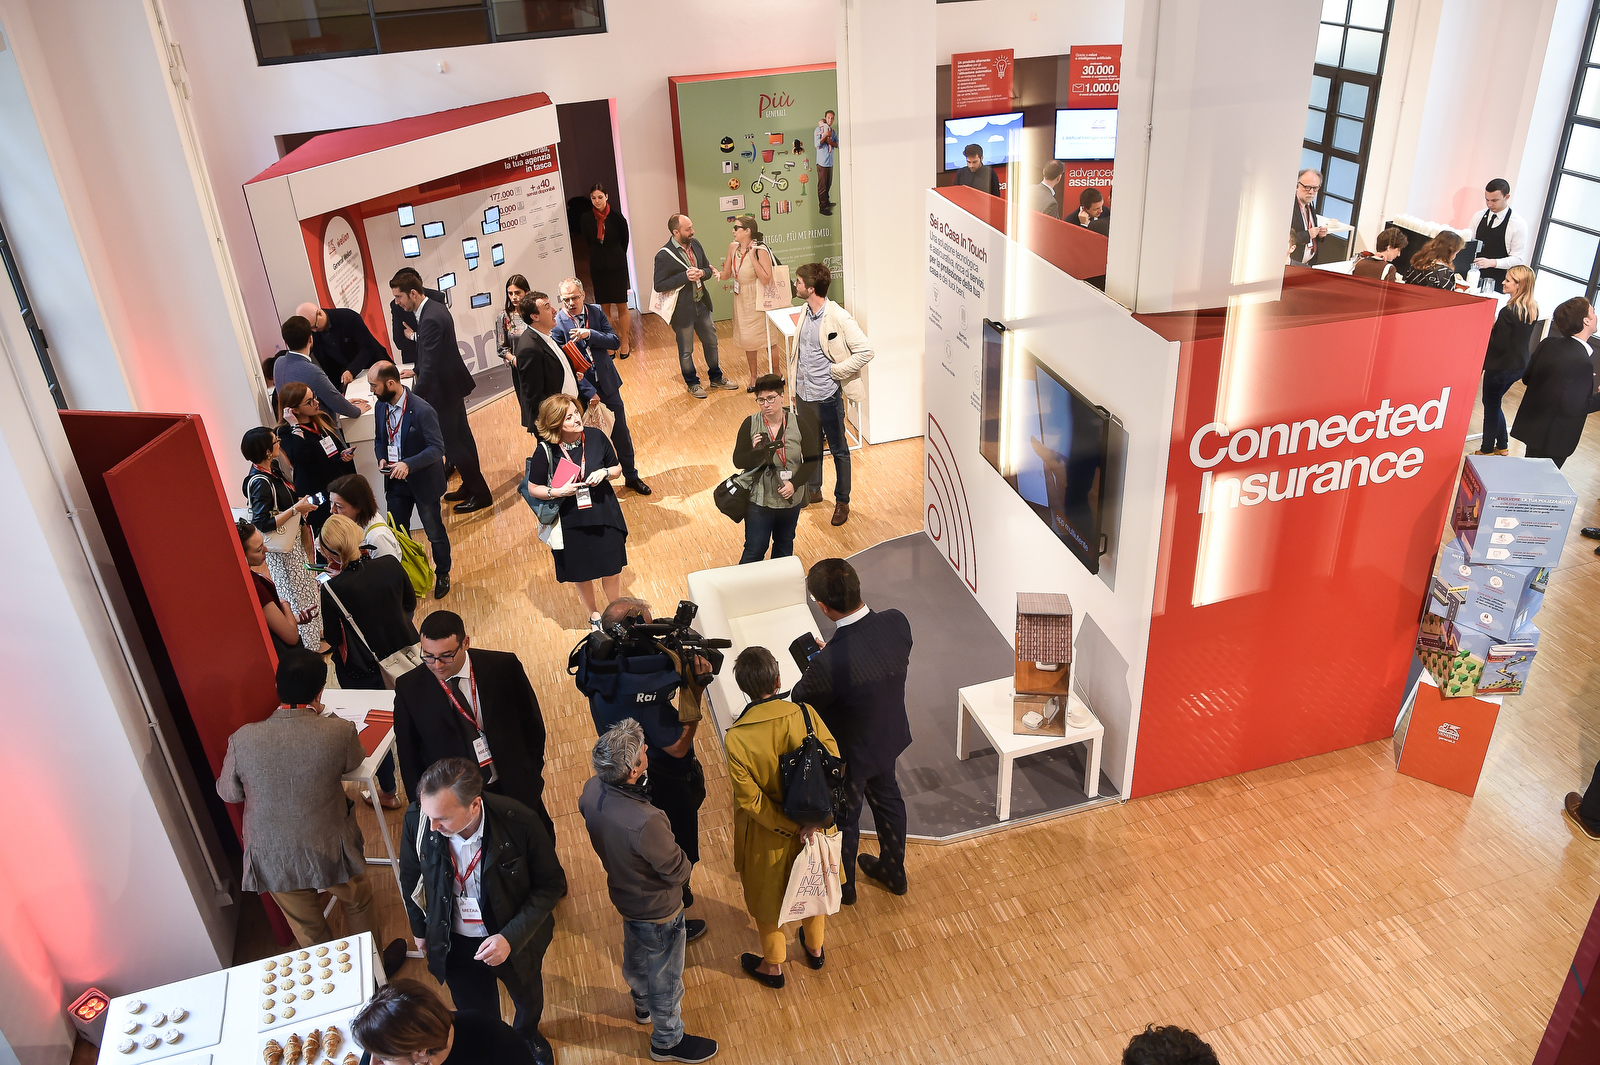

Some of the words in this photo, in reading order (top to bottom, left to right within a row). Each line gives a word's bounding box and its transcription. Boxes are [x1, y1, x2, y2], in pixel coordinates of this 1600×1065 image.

[1082, 65, 1114, 75] 30.000
[1085, 83, 1119, 93] 1.000.0
[512, 159, 524, 168] tua
[525, 153, 551, 165] agenzia
[533, 161, 552, 170] tasca
[540, 179, 550, 188] 40
[1068, 178, 1113, 187] assistan
[490, 189, 514, 201] 177.000
[500, 204, 516, 214] 0.000
[763, 234, 785, 244] TEGGO,
[808, 228, 832, 239] PREMIO.
[930, 213, 939, 230] Sei
[944, 223, 960, 244] Casa
[960, 233, 966, 249] In
[968, 238, 988, 263] Touch
[1188, 386, 1451, 469] Connected
[1198, 447, 1425, 514] Insurance
[636, 692, 656, 702] Rai
